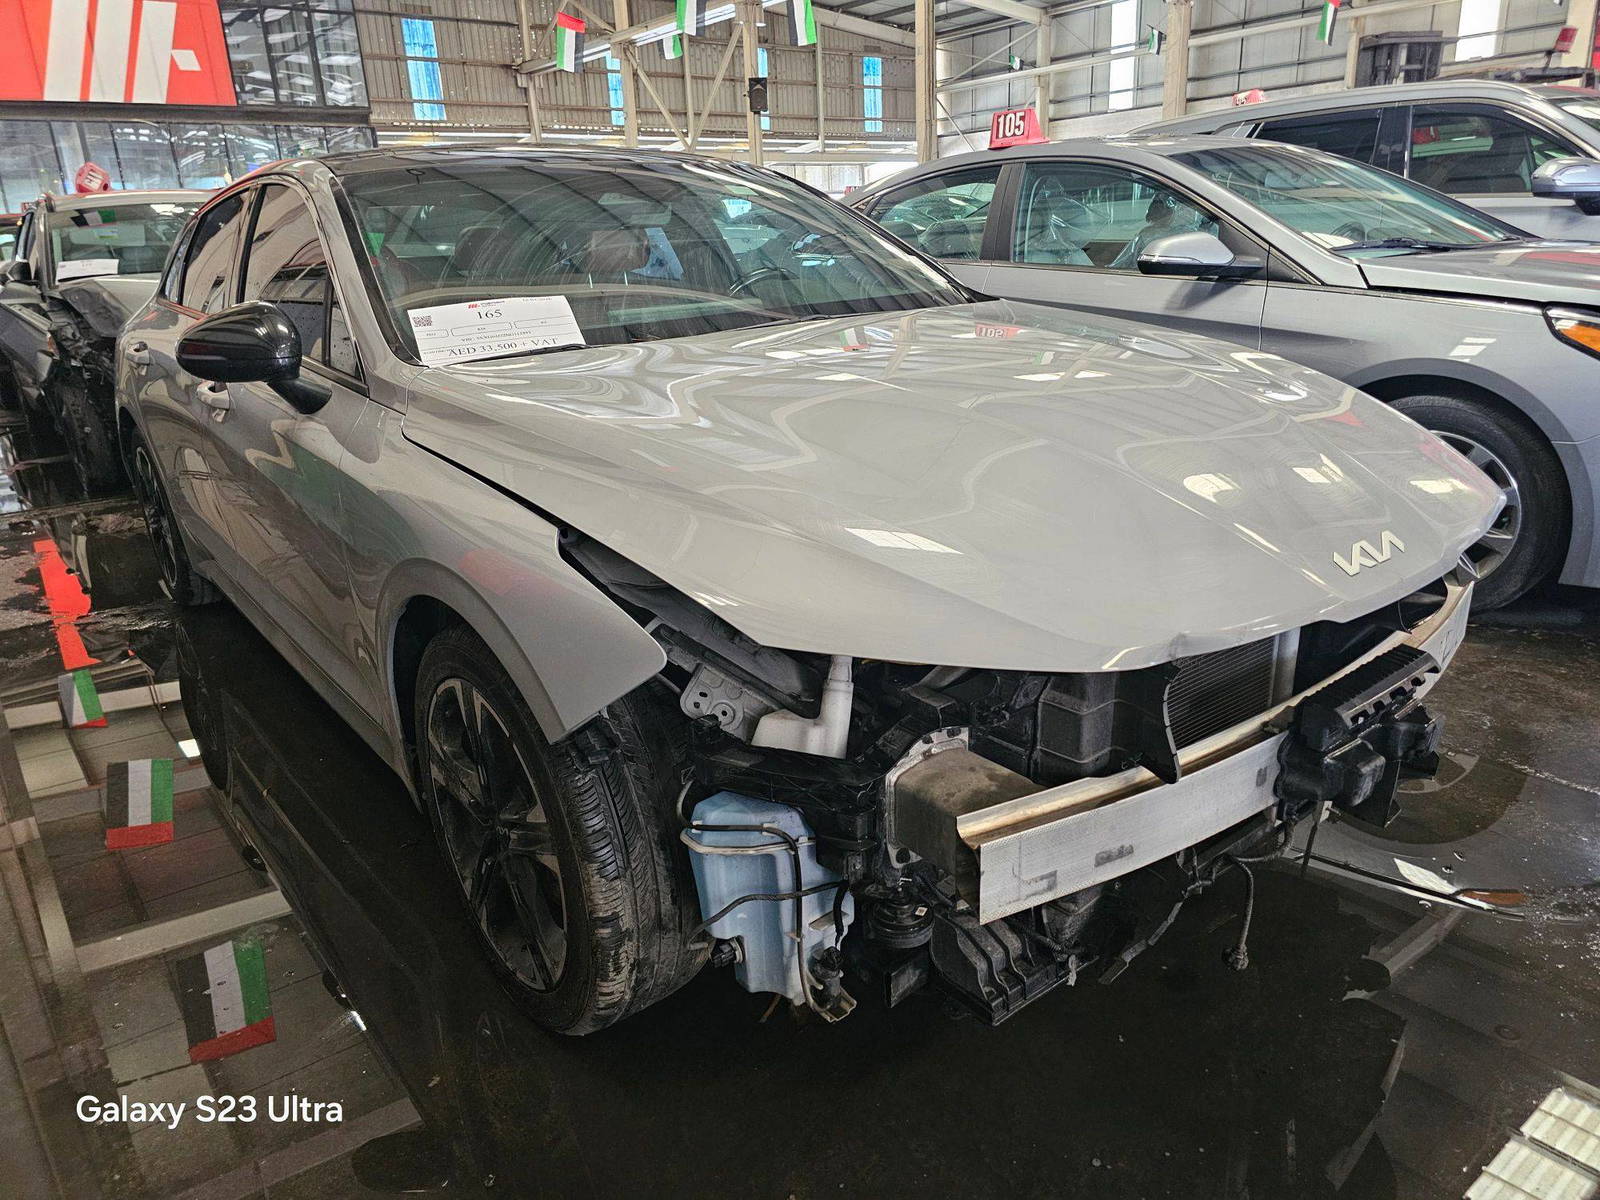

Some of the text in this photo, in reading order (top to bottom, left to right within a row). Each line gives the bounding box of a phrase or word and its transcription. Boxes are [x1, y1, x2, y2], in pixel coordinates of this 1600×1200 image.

[998, 111, 1025, 138] 105
[477, 309, 503, 319] 165
[448, 346, 477, 357] AED
[531, 338, 558, 346] VAT
[1333, 530, 1405, 577] KIA
